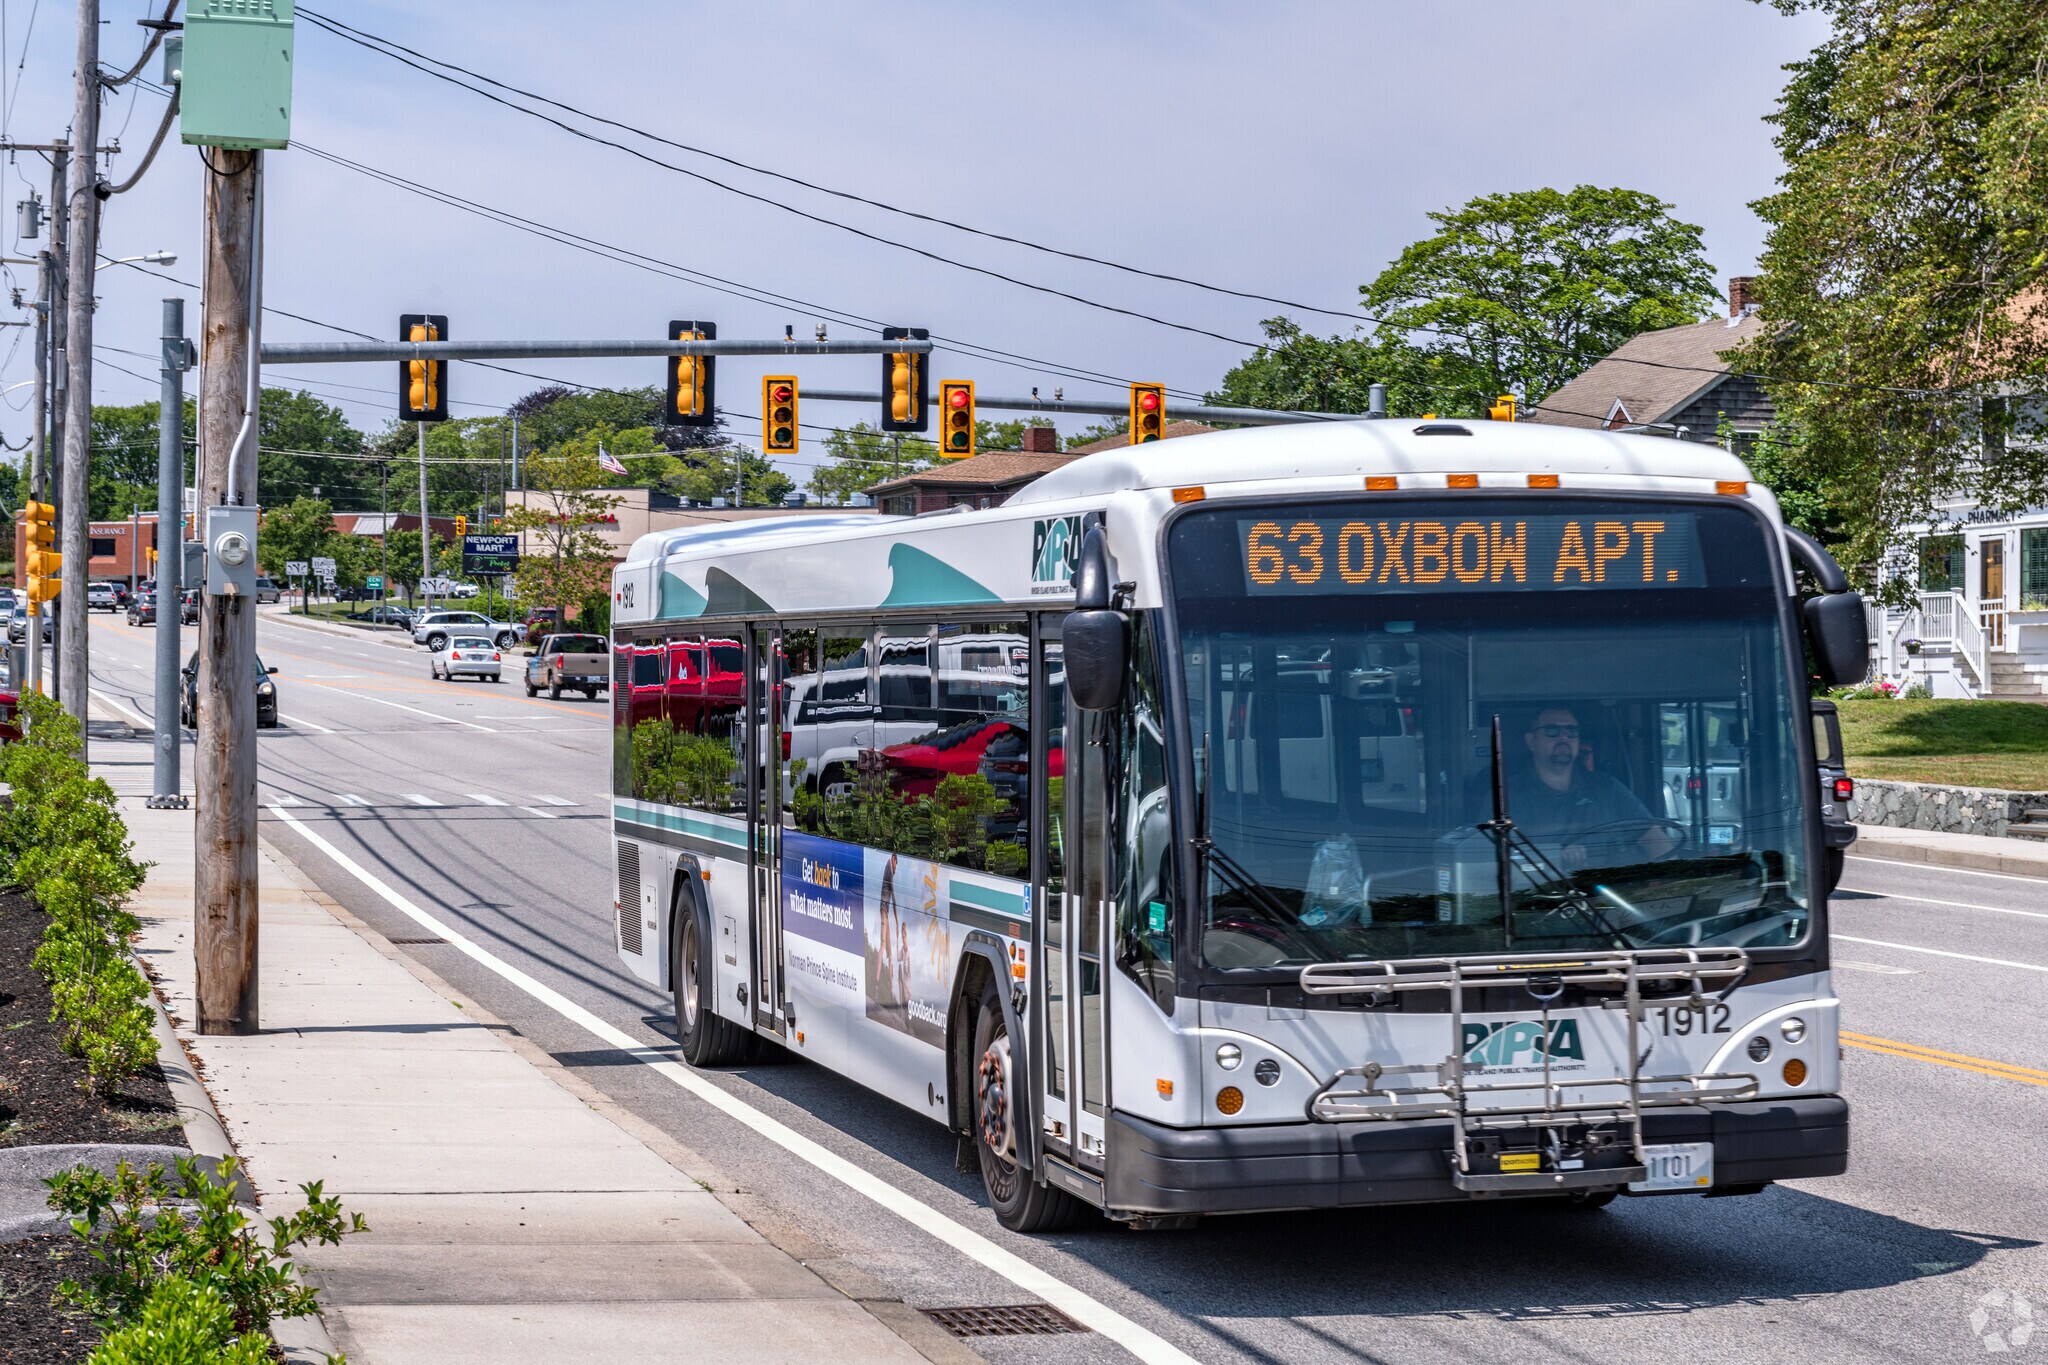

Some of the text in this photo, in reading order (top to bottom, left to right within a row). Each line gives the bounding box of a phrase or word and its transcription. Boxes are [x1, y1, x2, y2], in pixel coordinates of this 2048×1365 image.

[1968, 508, 2015, 525] PHARMACY
[90, 526, 126, 535] INSURANCE
[466, 535, 514, 544] NEWPORT
[476, 544, 504, 552] MART
[1248, 520, 1679, 584] 63 OXBOW APT.
[322, 568, 336, 576] 138
[506, 589, 519, 598] 114
[623, 582, 634, 609] 1912
[802, 857, 840, 891] Get back to
[789, 889, 854, 931] what matters most.
[788, 949, 858, 992] Norman Prince Spine Institute
[908, 998, 948, 1035] goodback.org
[1656, 1002, 1732, 1036] 1912
[1460, 1018, 1585, 1066] RIPTA
[1499, 1066, 1521, 1075] PUBLIC
